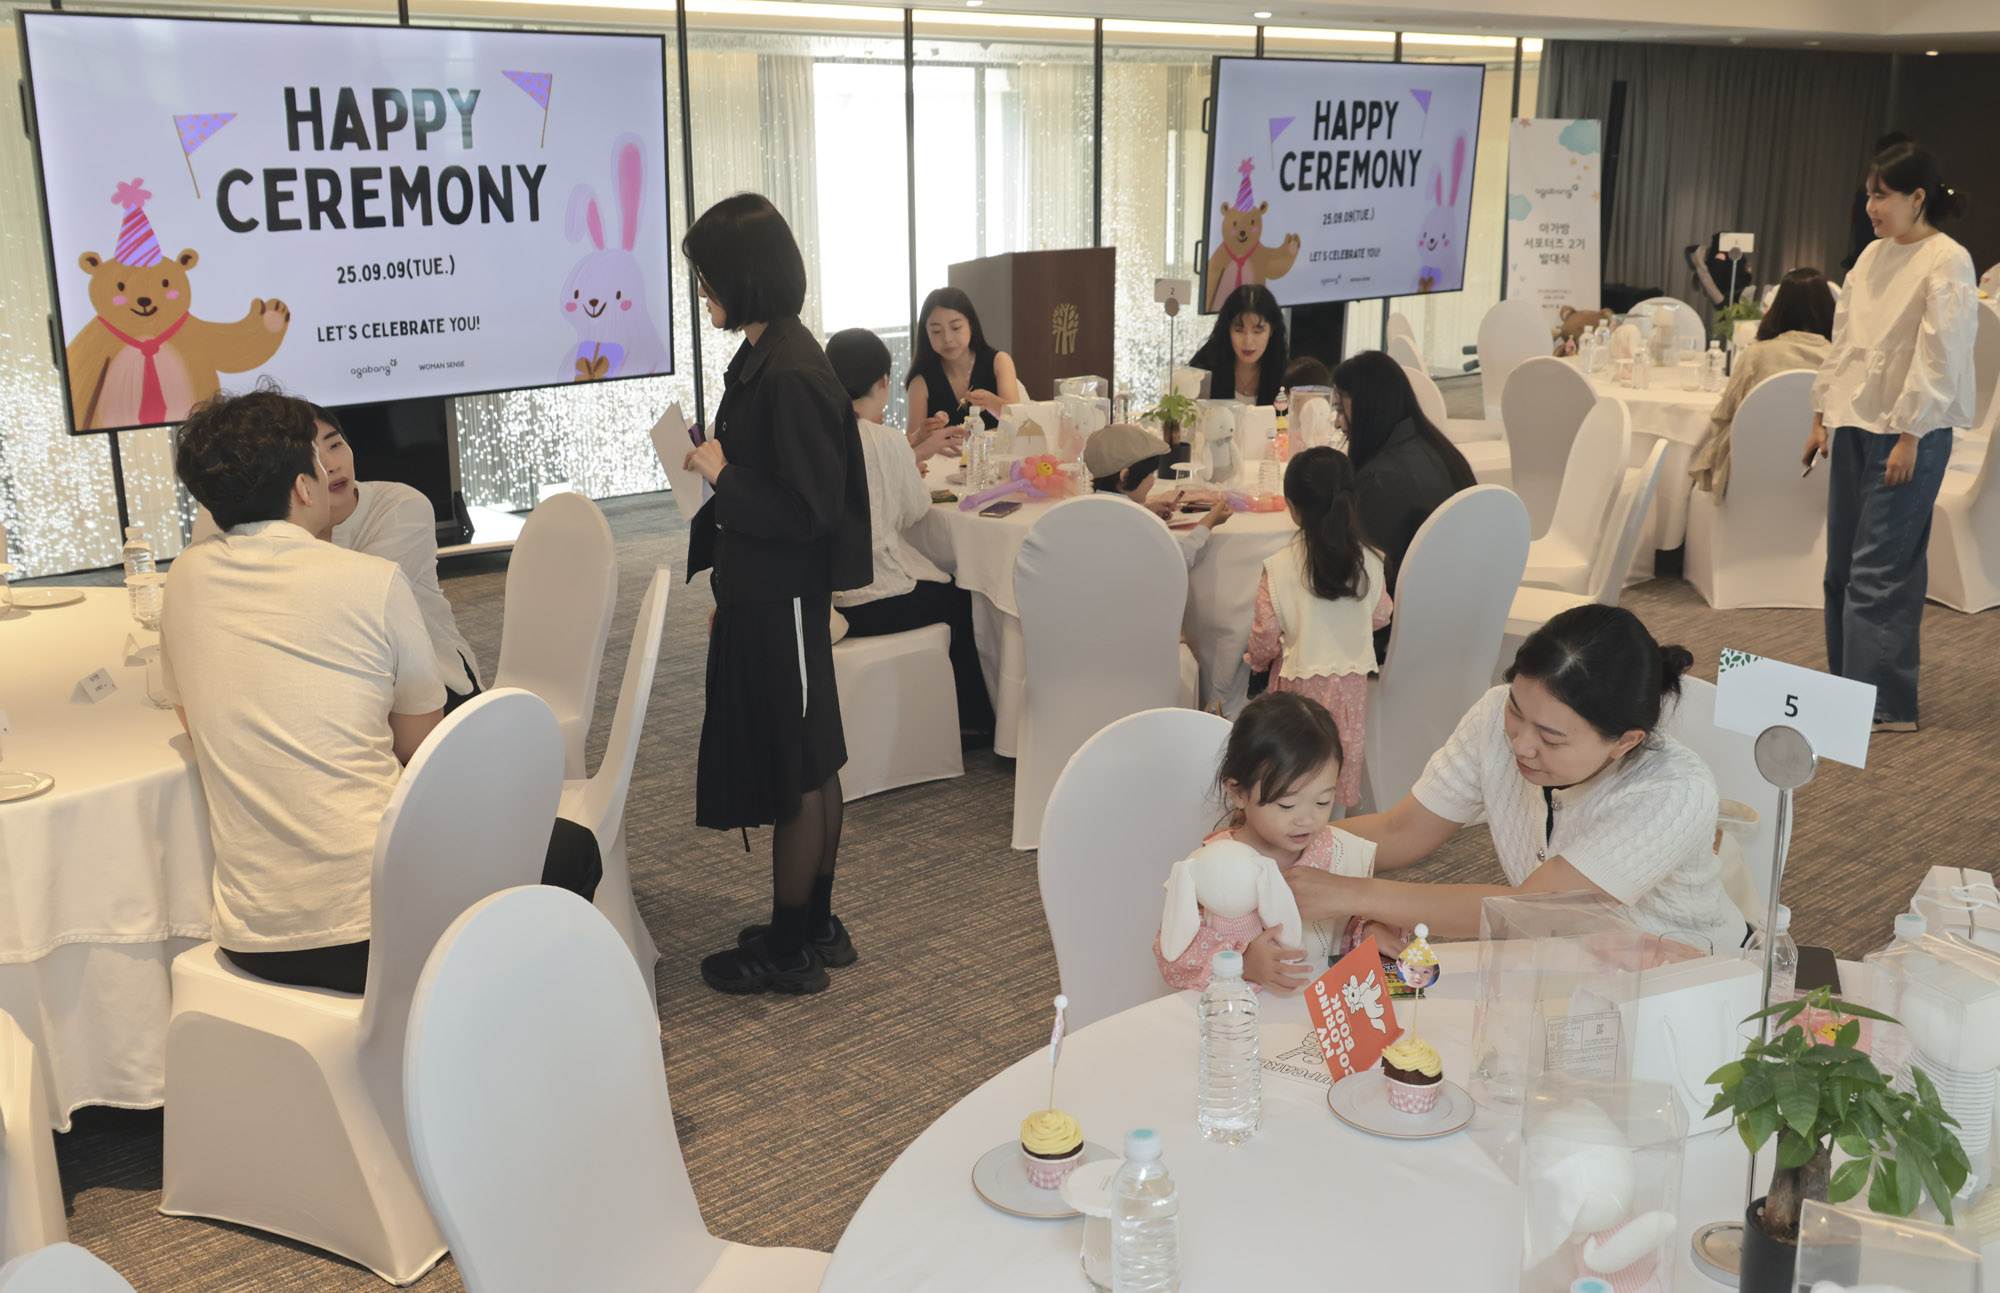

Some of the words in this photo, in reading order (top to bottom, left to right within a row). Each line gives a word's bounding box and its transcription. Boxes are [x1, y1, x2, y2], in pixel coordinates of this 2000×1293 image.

[284, 87, 481, 151] HAPPY
[1313, 100, 1399, 141] HAPPY
[1279, 149, 1422, 192] CEREMONY
[216, 164, 547, 233] CEREMONY
[1539, 223, 1570, 235] 아가방
[1328, 248, 1365, 261] CELEBRATE
[1568, 238, 1586, 250] 2기
[337, 254, 455, 284] 25.09.09(TUE.)
[1170, 287, 1175, 295] 2
[317, 324, 357, 342] LET'S
[361, 317, 445, 339] CELEBRATE
[449, 315, 480, 332] YOU!
[350, 363, 391, 379] agabang
[418, 362, 445, 371] WOMAN
[446, 360, 465, 369] SENSE
[1784, 694, 1799, 717] 5
[1331, 993, 1355, 1052] BOOK
[1316, 1028, 1335, 1059] MY
